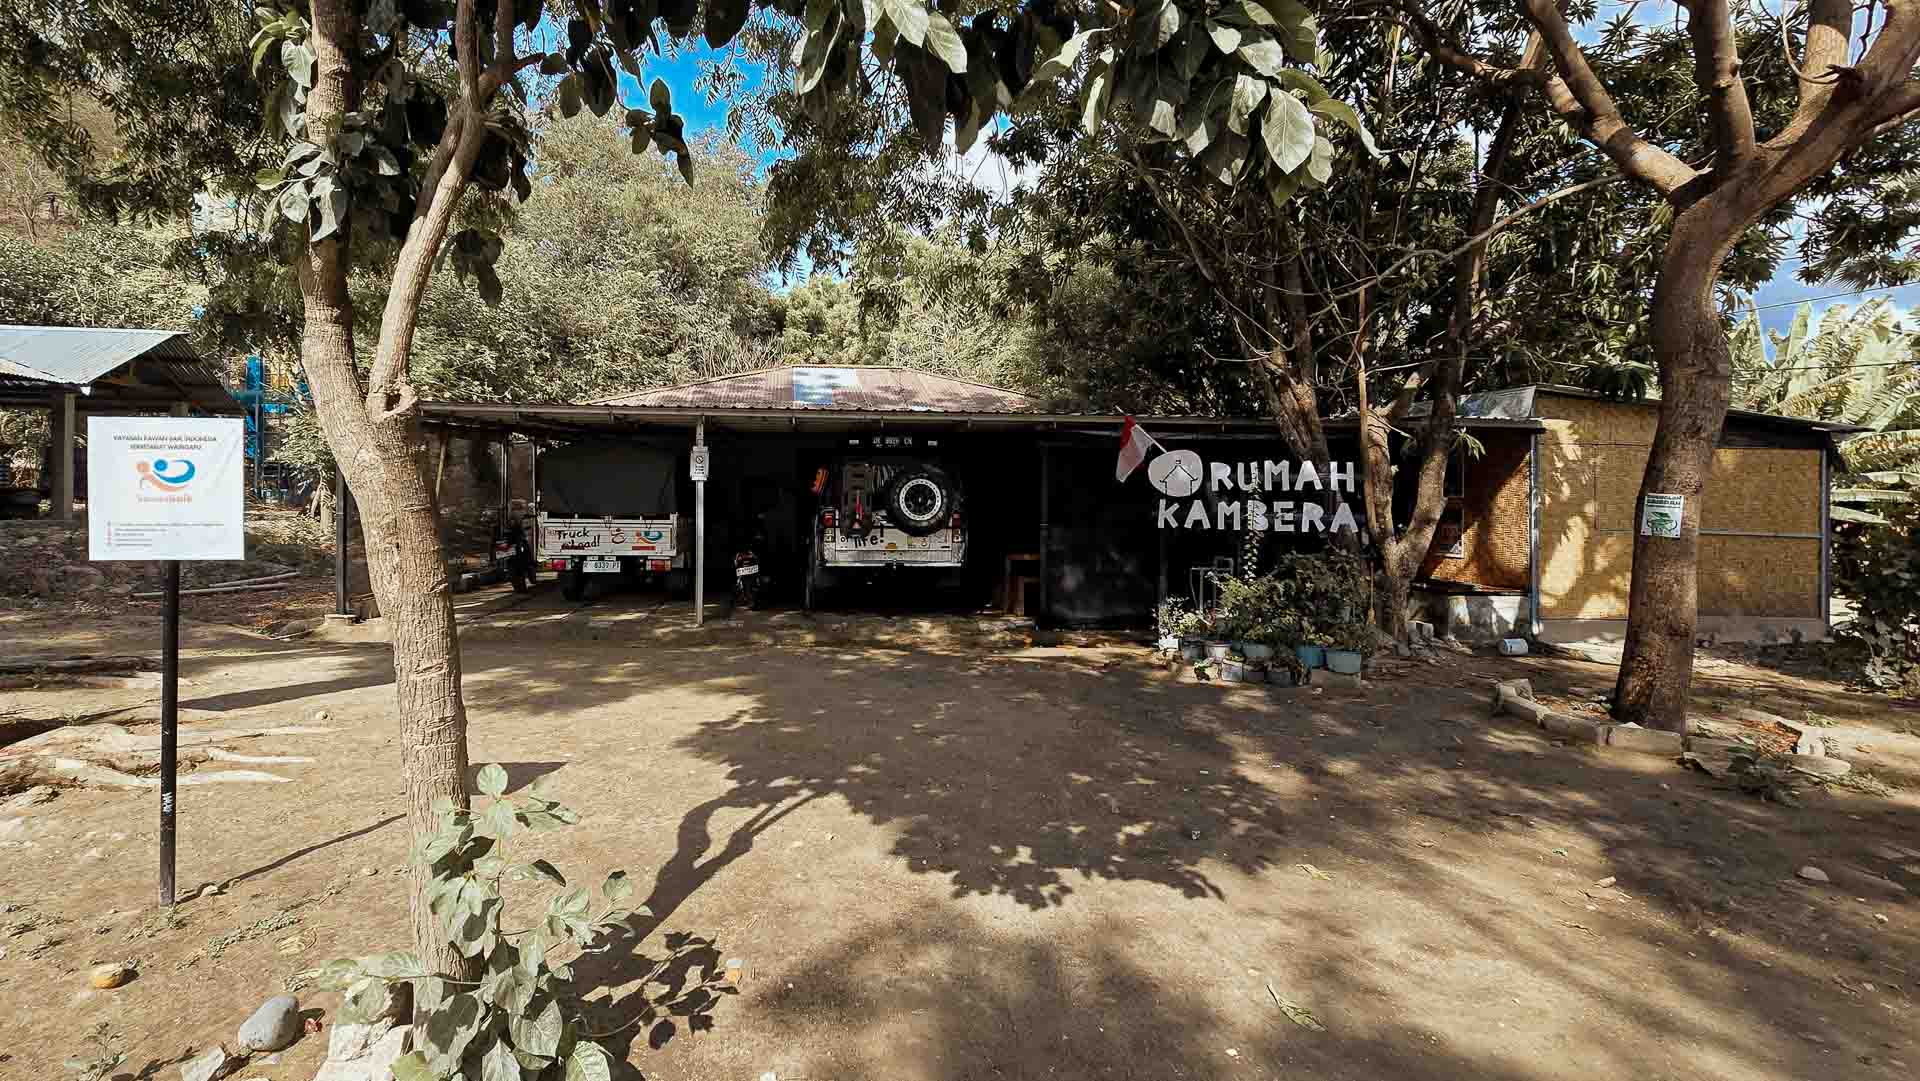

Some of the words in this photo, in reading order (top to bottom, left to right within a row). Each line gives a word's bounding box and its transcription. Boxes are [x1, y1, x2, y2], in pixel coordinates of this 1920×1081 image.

[1210, 459, 1355, 492] RUMAH
[1157, 499, 1359, 533] KAMBERA
[555, 527, 590, 540] Truck
